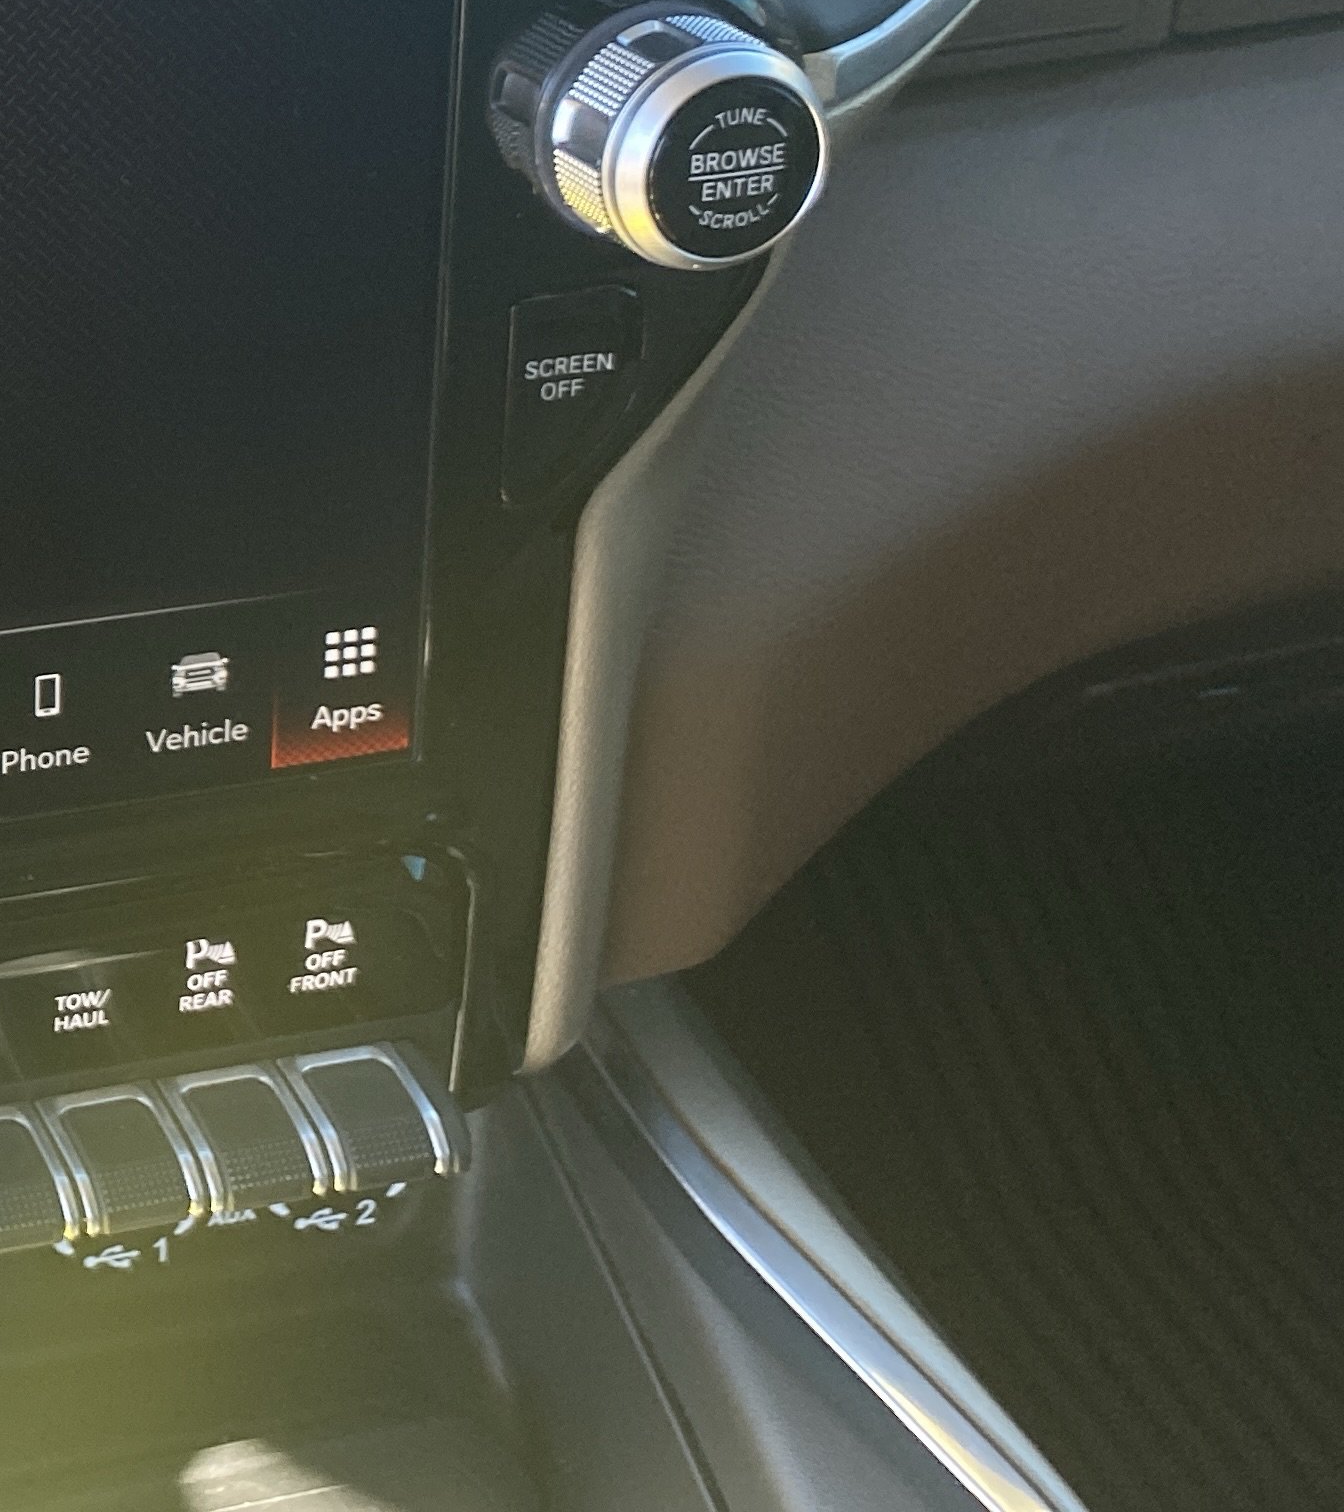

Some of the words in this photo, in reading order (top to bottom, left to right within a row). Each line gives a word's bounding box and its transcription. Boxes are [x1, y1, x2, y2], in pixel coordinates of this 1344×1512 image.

[715, 106, 769, 129] TUNE
[690, 142, 787, 175] BROWSE
[701, 174, 775, 202] ENTER
[698, 202, 770, 230] SCROLL
[524, 352, 614, 378] SCREEN
[540, 378, 585, 402] OFF
[310, 701, 385, 732] Apps
[144, 718, 250, 753] Vehicle
[1, 742, 91, 774] Phone
[304, 949, 347, 972] OFF
[186, 969, 228, 992] OFF
[289, 968, 359, 994] FRONT
[54, 987, 112, 1013] TOW/
[178, 989, 234, 1013] REAR
[53, 1010, 110, 1033] HAUL
[355, 1198, 377, 1226] 2
[152, 1236, 170, 1263] 1
